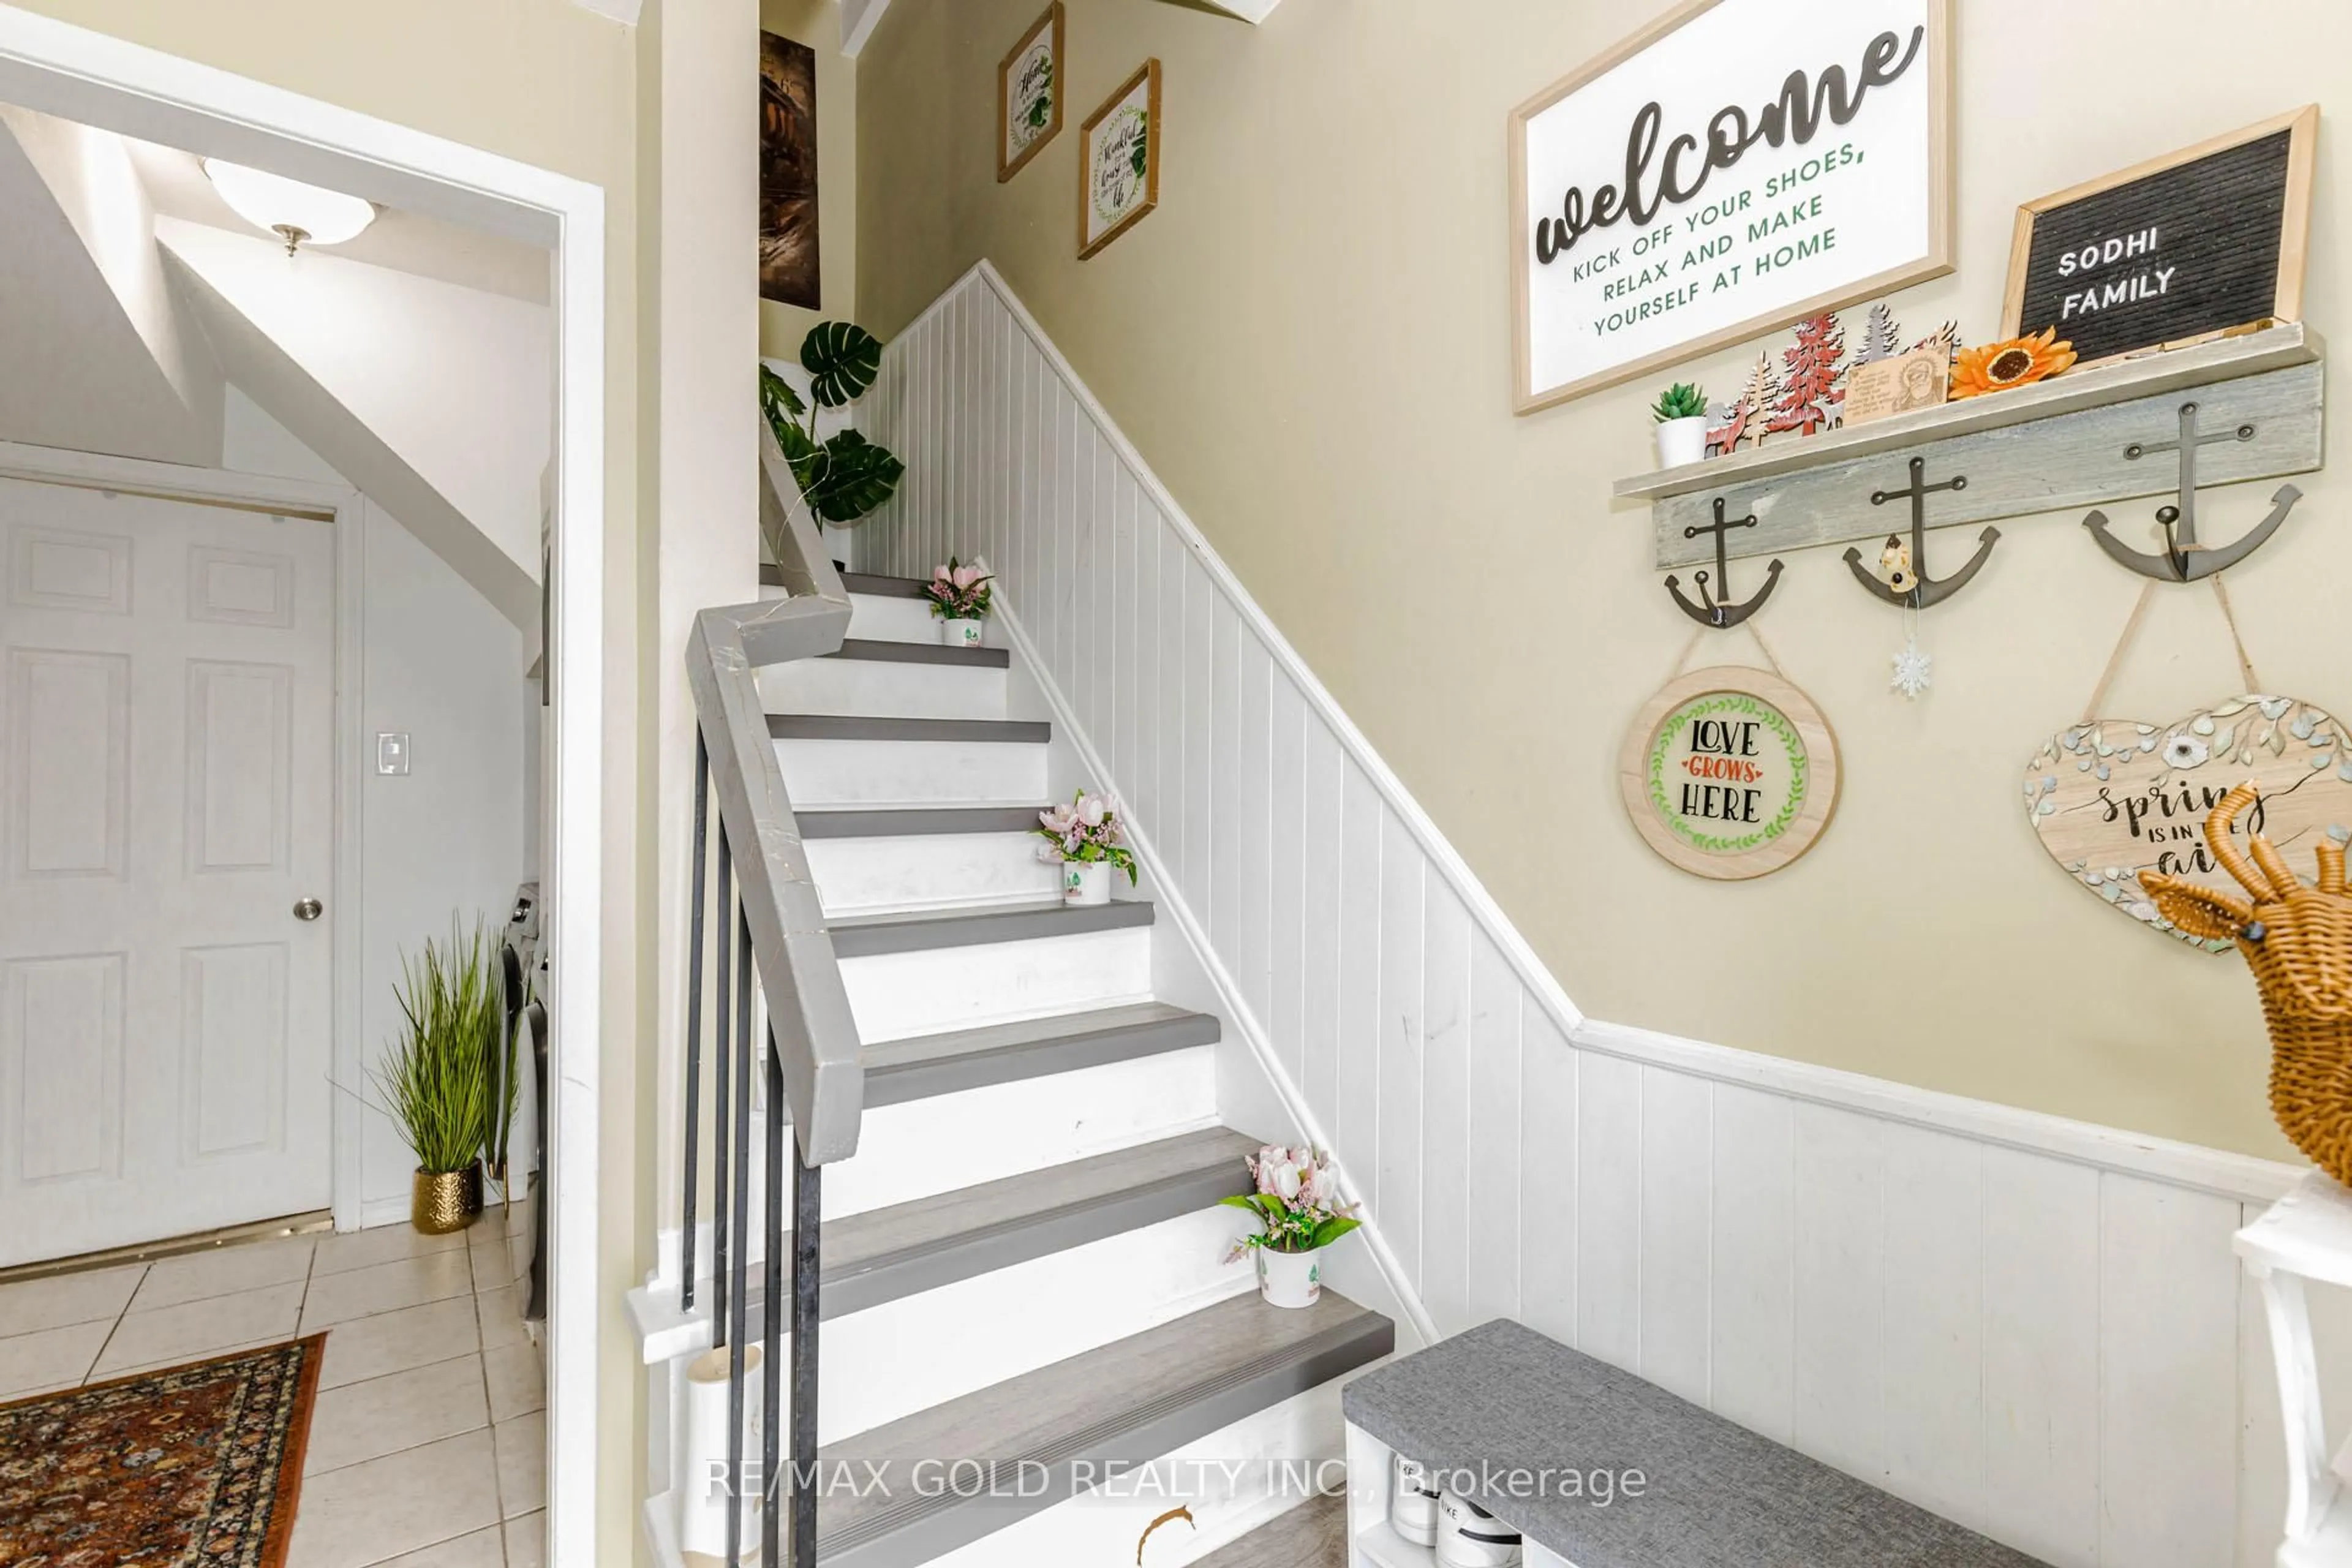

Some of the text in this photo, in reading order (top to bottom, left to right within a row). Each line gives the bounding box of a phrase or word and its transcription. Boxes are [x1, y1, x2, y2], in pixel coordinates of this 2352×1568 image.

[1536, 24, 1924, 265] welcome
[1574, 143, 1865, 283] KICK OFF YOUR SHOES,
[1604, 195, 1823, 302] RELAX AND MAKE
[2059, 227, 2158, 276] SODHI
[1594, 228, 1836, 337] YOURSELF AT HOME
[2063, 267, 2176, 320] FAMILY
[1690, 720, 1760, 756] LOVE
[1689, 755, 1755, 783] GROWS
[1681, 783, 1761, 823] HERE
[2149, 826, 2165, 843] IS
[2173, 824, 2193, 840] IN
